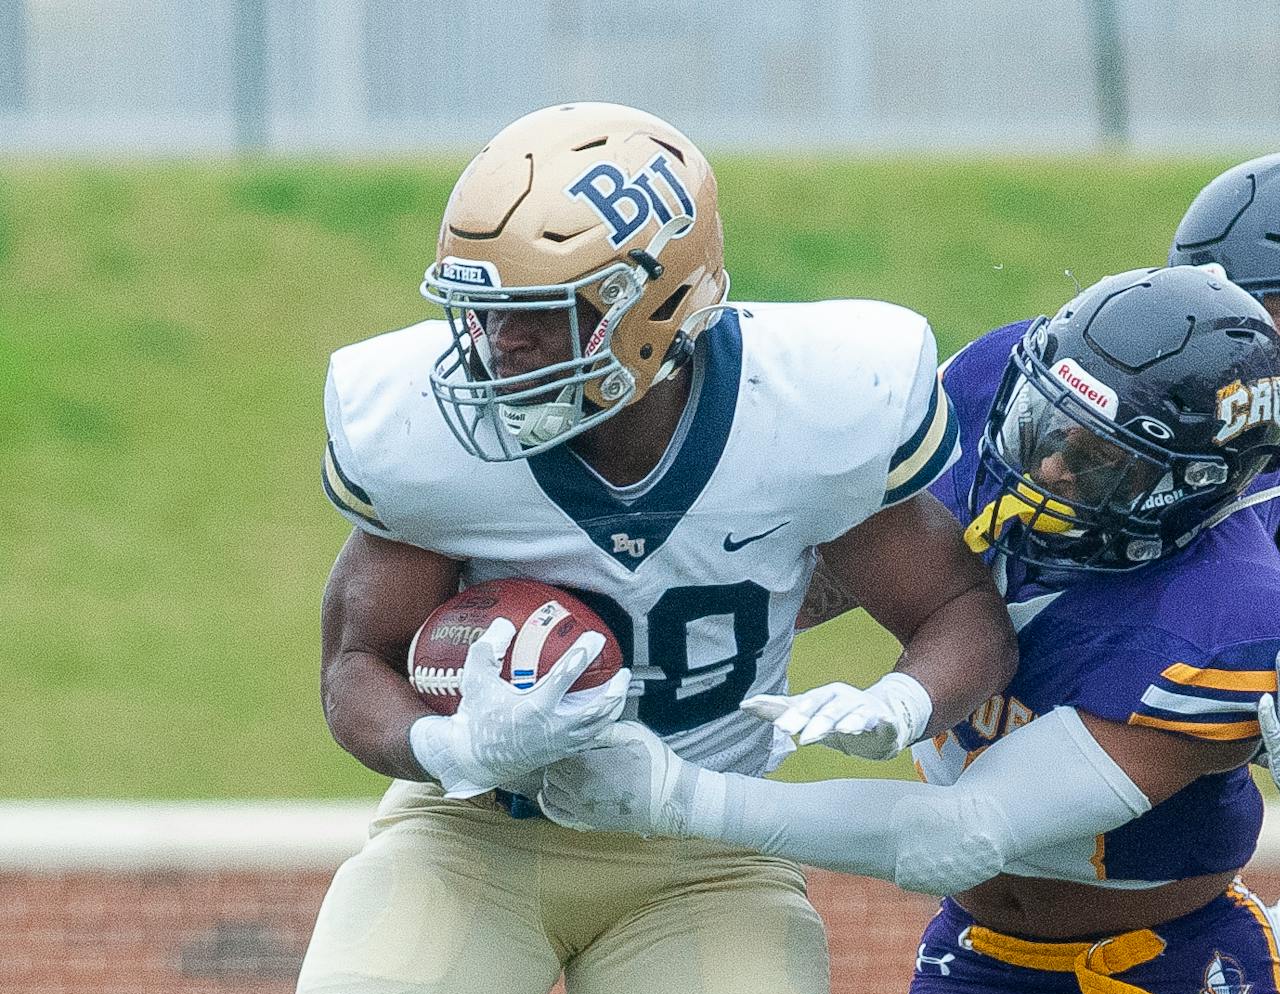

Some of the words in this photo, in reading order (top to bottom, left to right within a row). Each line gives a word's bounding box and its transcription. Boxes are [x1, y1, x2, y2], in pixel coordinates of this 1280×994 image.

[563, 152, 699, 250] BU
[1057, 364, 1109, 408] Riddell
[610, 532, 646, 558] BU
